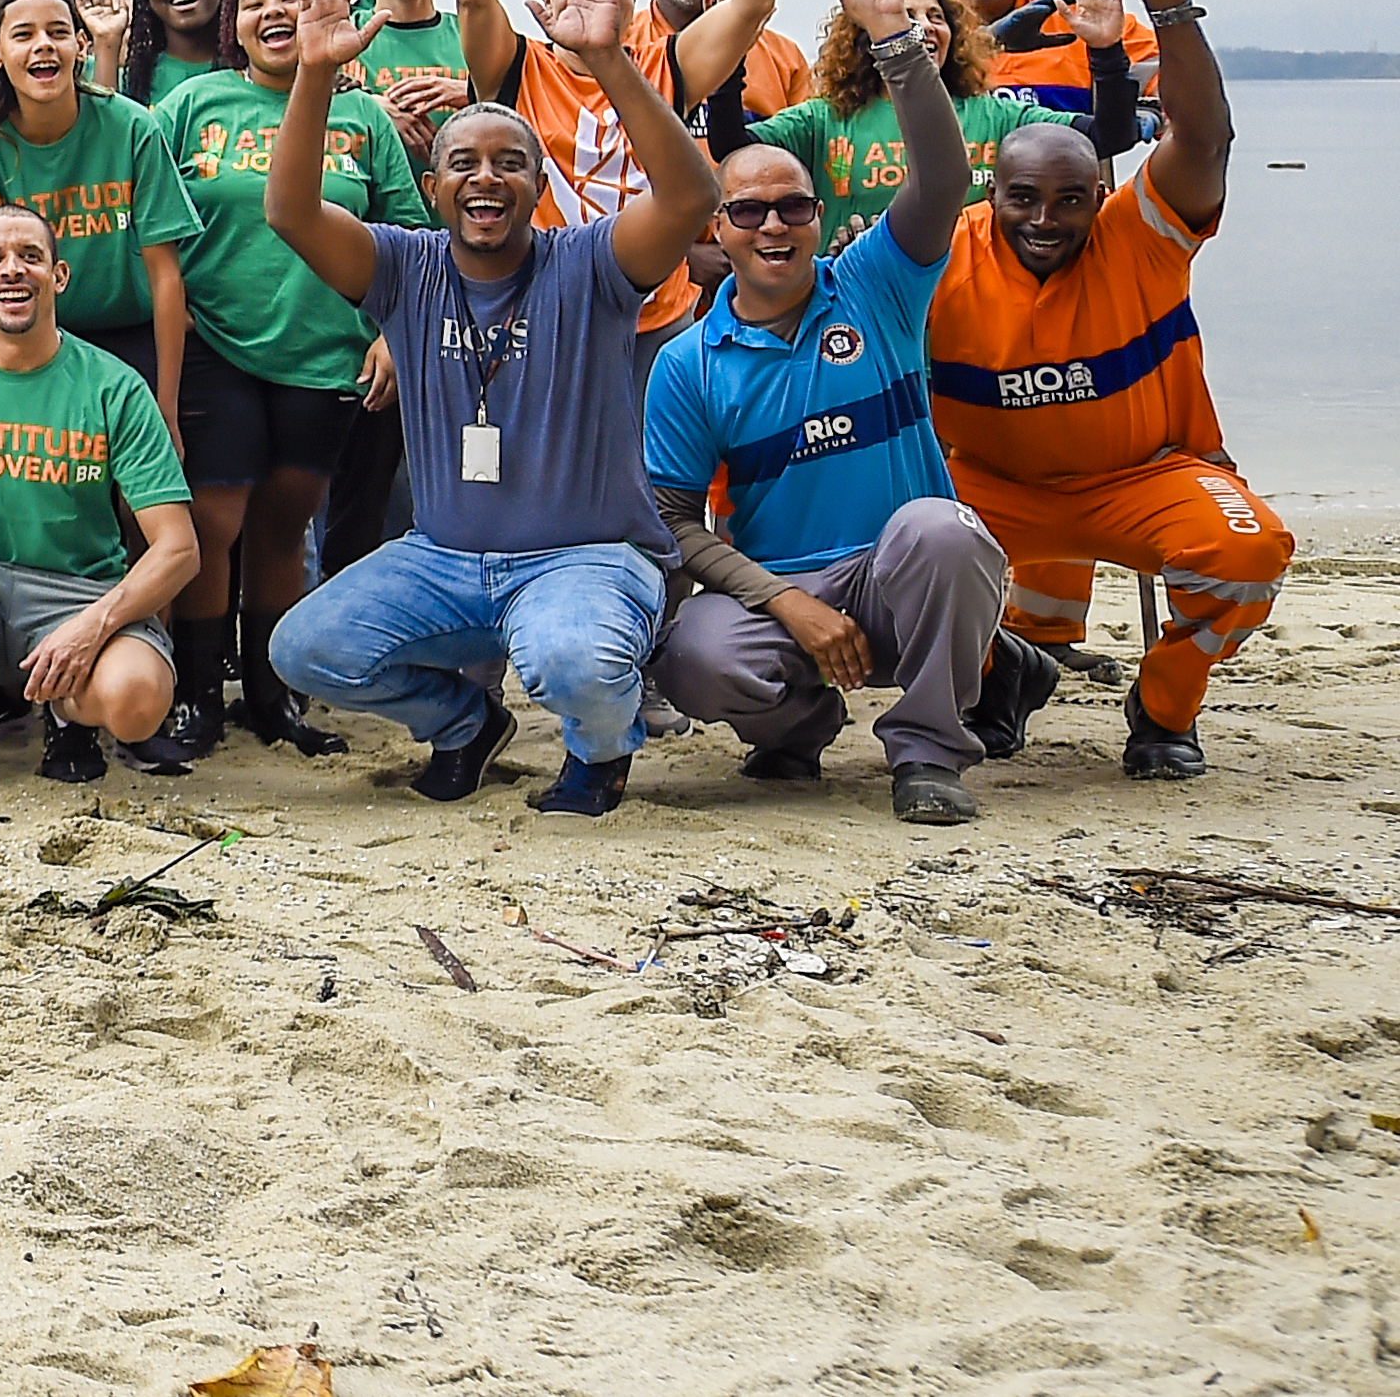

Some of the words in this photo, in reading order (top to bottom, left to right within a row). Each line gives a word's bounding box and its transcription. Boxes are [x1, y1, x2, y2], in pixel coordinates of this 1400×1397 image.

[235, 127, 367, 160] ATDE
[864, 141, 997, 166] ATDE
[50, 212, 112, 239] VEM
[998, 366, 1064, 396] RIO
[1002, 387, 1099, 408] PREFEITURA
[790, 435, 857, 460] EFEITURA
[76, 465, 102, 483] BR
